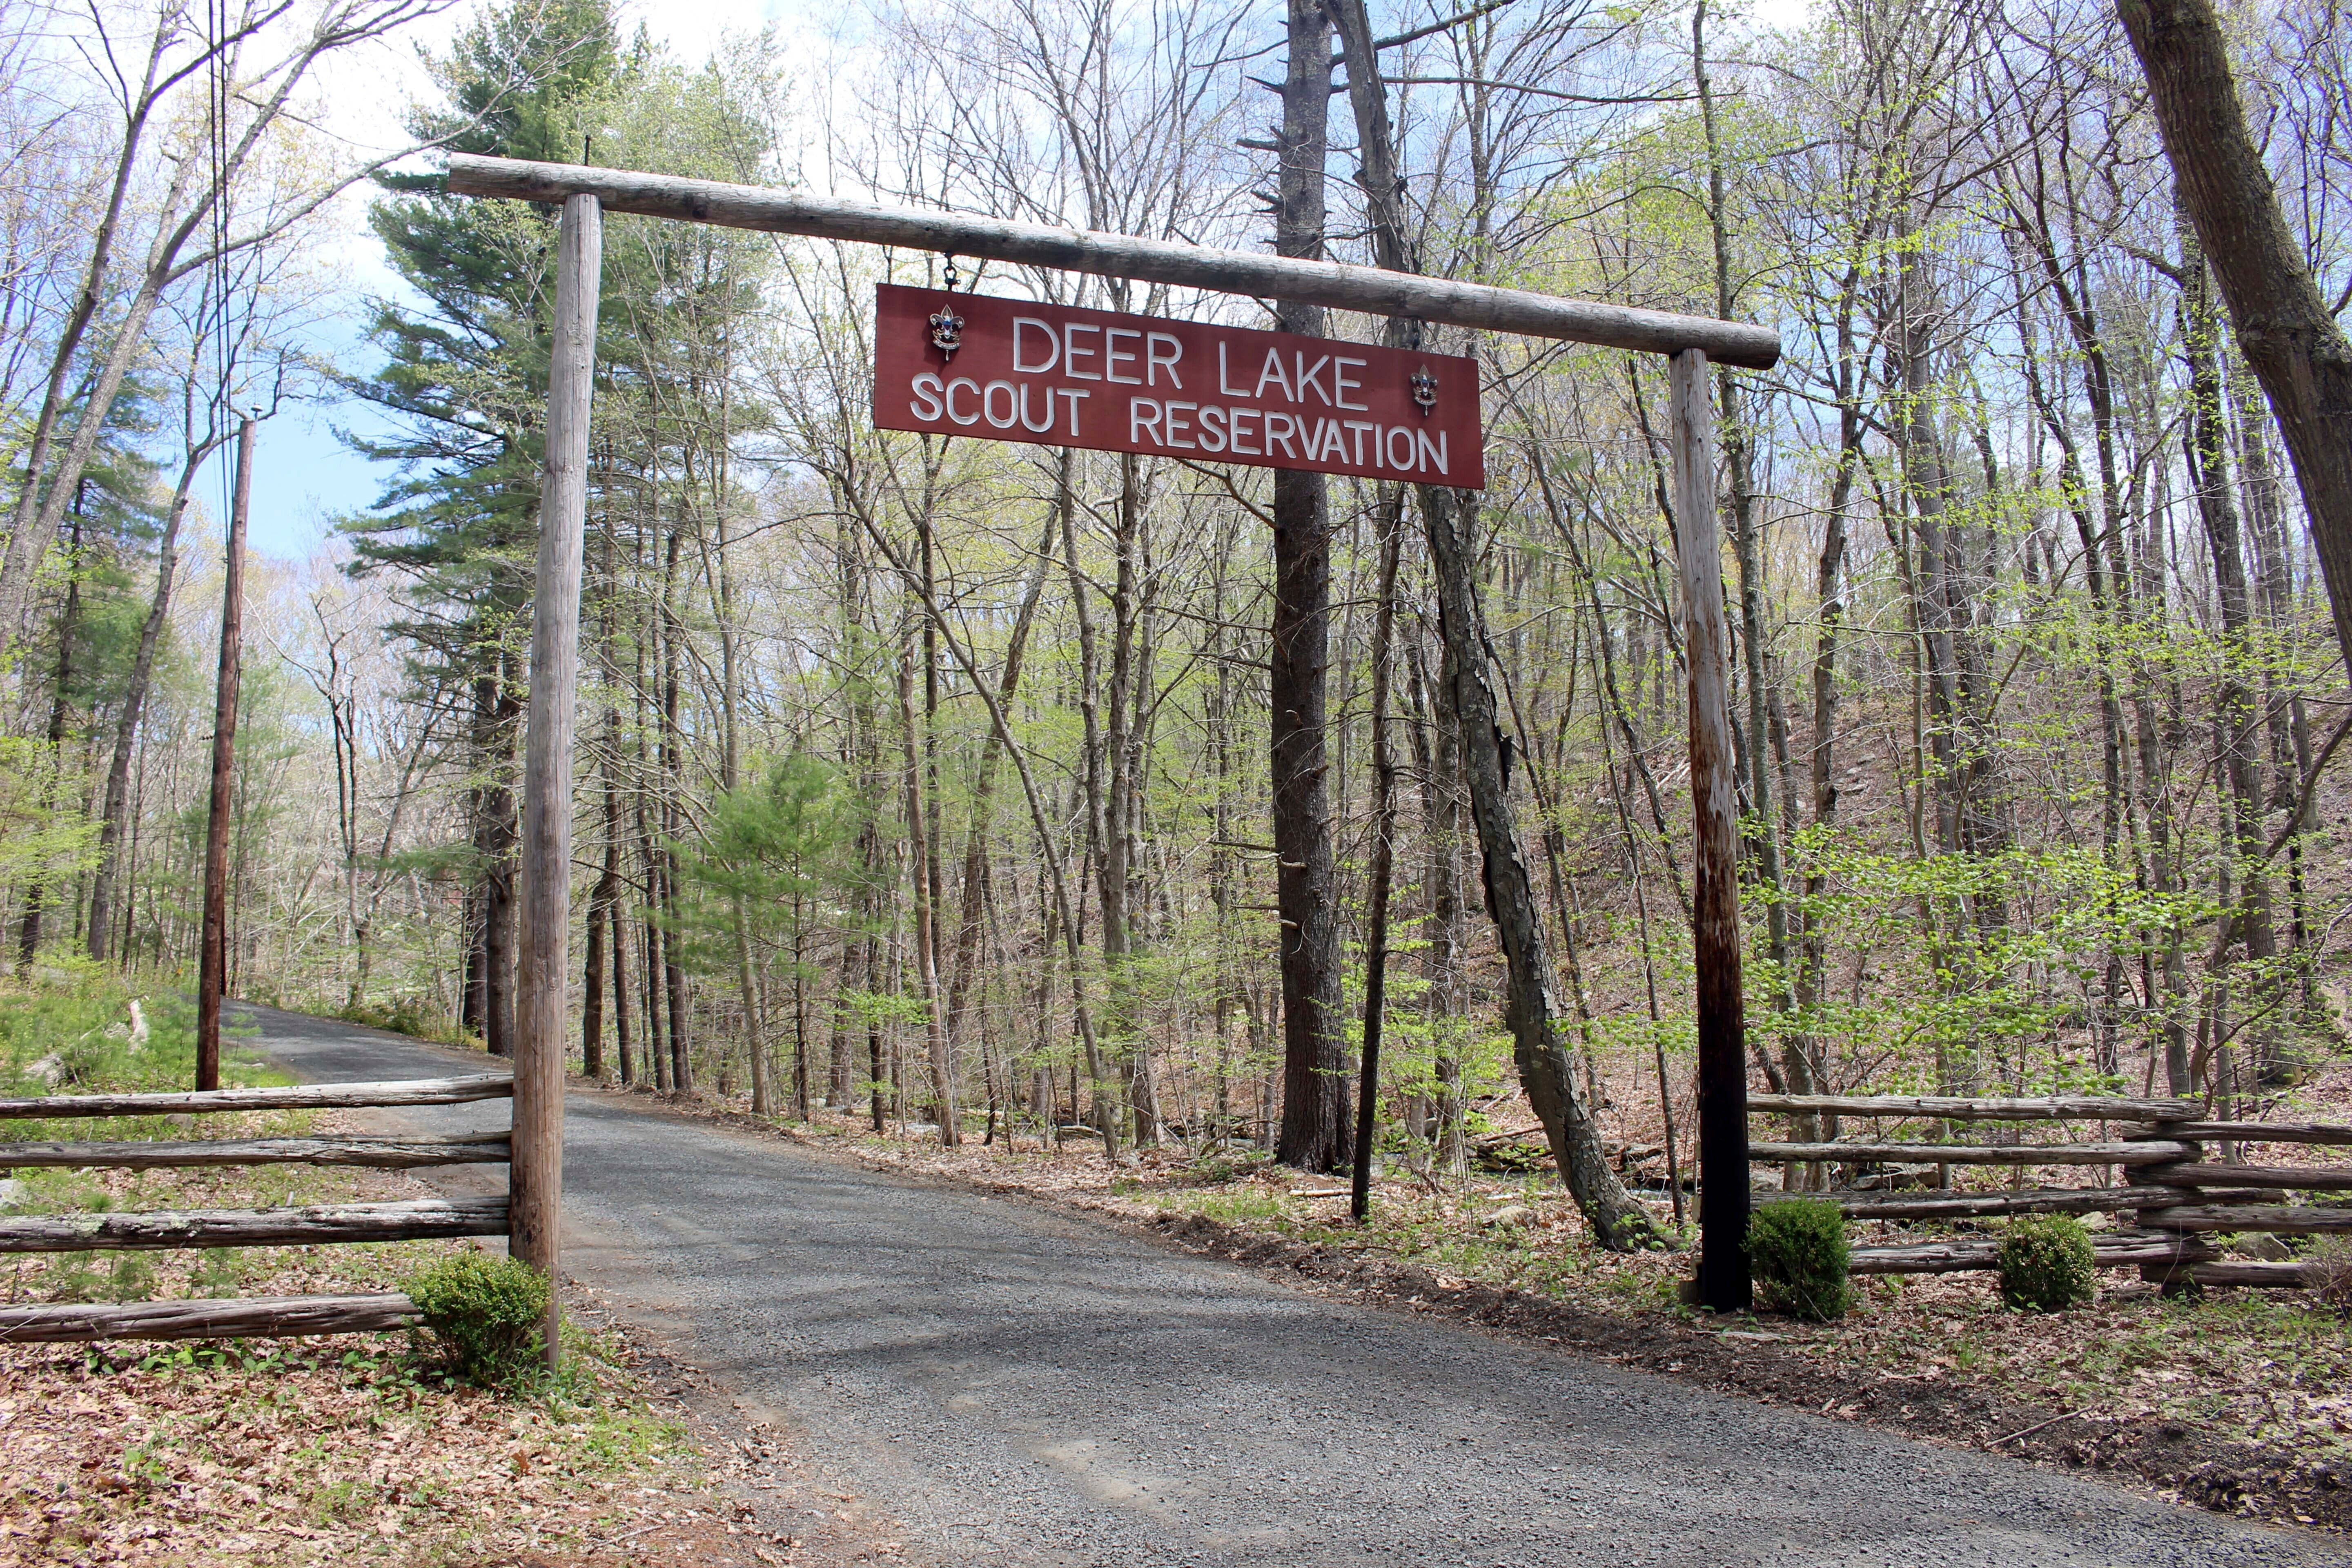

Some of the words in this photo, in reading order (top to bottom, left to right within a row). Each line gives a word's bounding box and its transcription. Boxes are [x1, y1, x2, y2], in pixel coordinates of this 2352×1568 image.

[1012, 316, 1183, 390] DEER
[1218, 340, 1369, 412] LAKE
[909, 372, 1091, 437] SCOUT
[1130, 396, 1449, 475] RESERVATION
